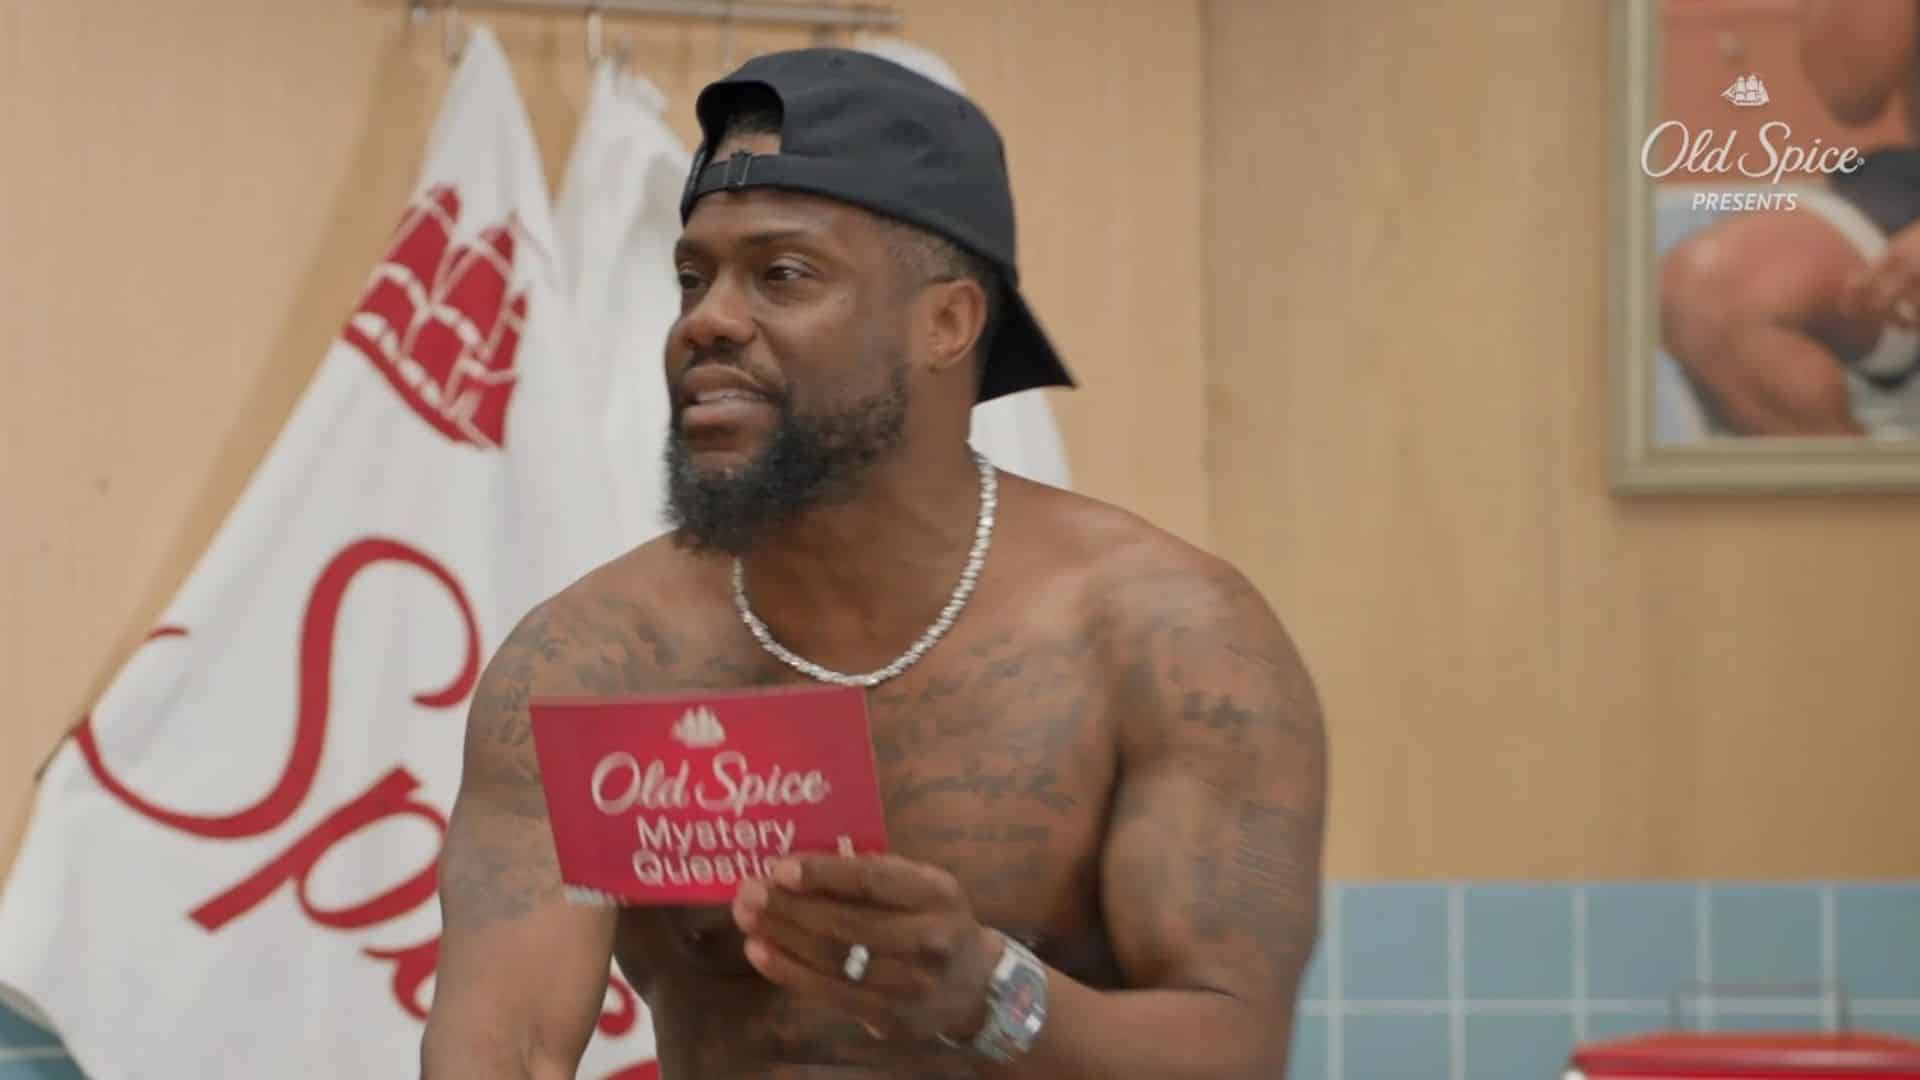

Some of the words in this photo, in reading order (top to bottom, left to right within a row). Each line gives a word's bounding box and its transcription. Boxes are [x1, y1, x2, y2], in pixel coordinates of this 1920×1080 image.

[591, 751, 690, 816] Old
[694, 751, 828, 817] Spice
[636, 815, 796, 856] Mystery
[632, 850, 772, 887] Questi
